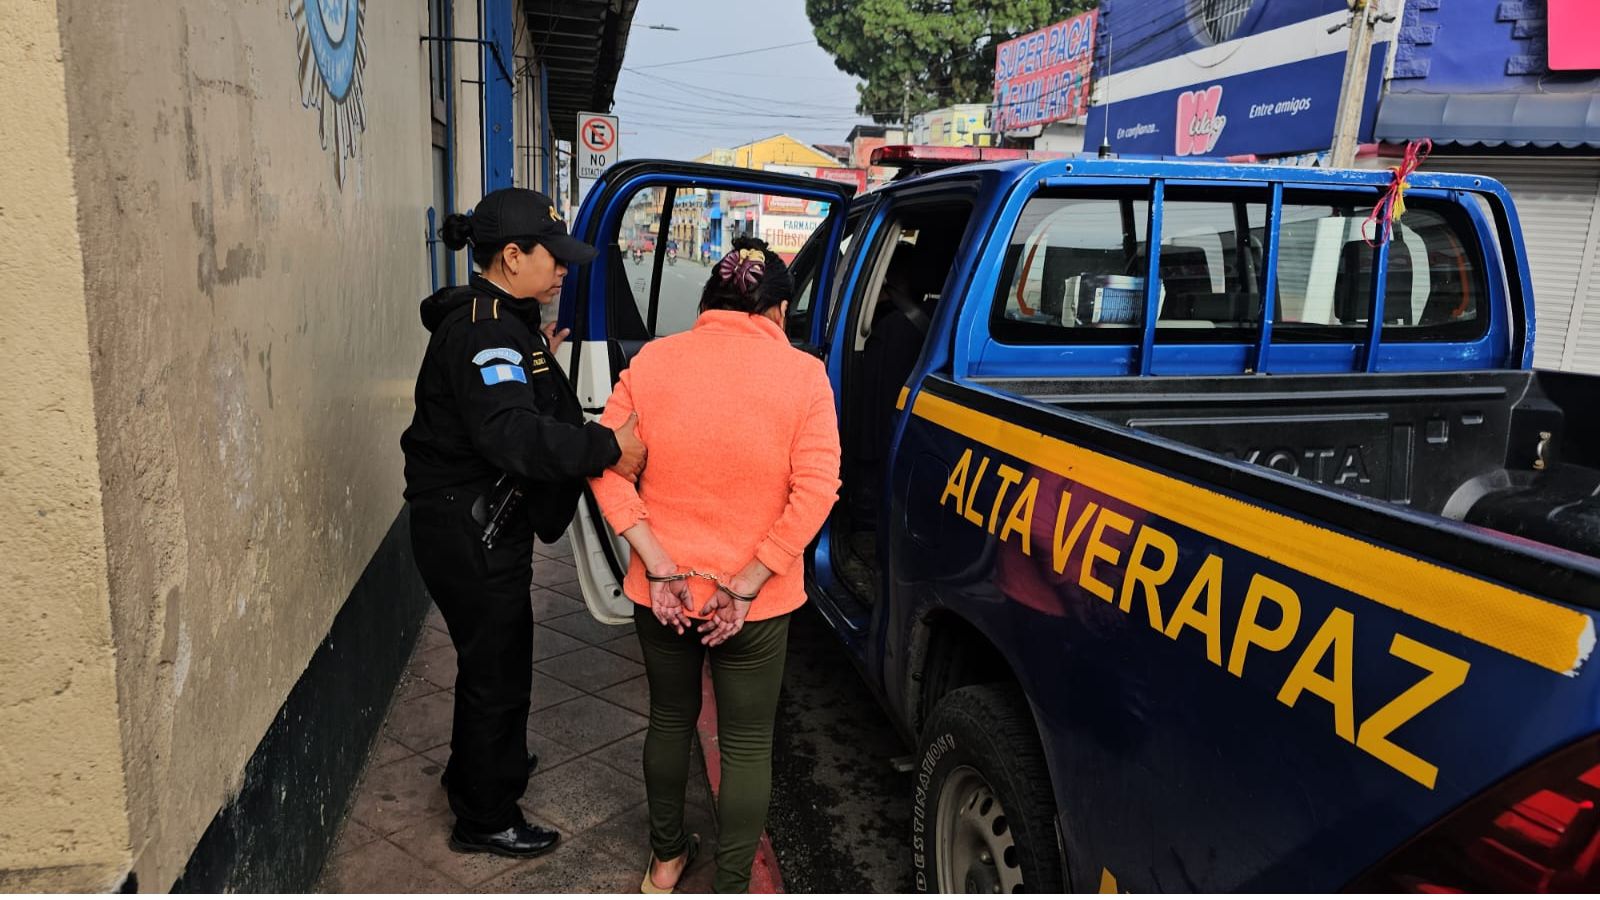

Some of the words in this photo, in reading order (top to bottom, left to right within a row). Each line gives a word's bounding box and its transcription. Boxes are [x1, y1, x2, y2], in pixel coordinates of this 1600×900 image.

[997, 31, 1047, 82] SUPER
[1046, 14, 1092, 70] PACA
[1006, 69, 1073, 126] FAMILIAR
[1249, 103, 1274, 119] Entre
[1274, 97, 1311, 116] amigos
[590, 153, 606, 167] NO
[940, 448, 1040, 556] ALTA
[1050, 490, 1471, 790] VERAPAZ
